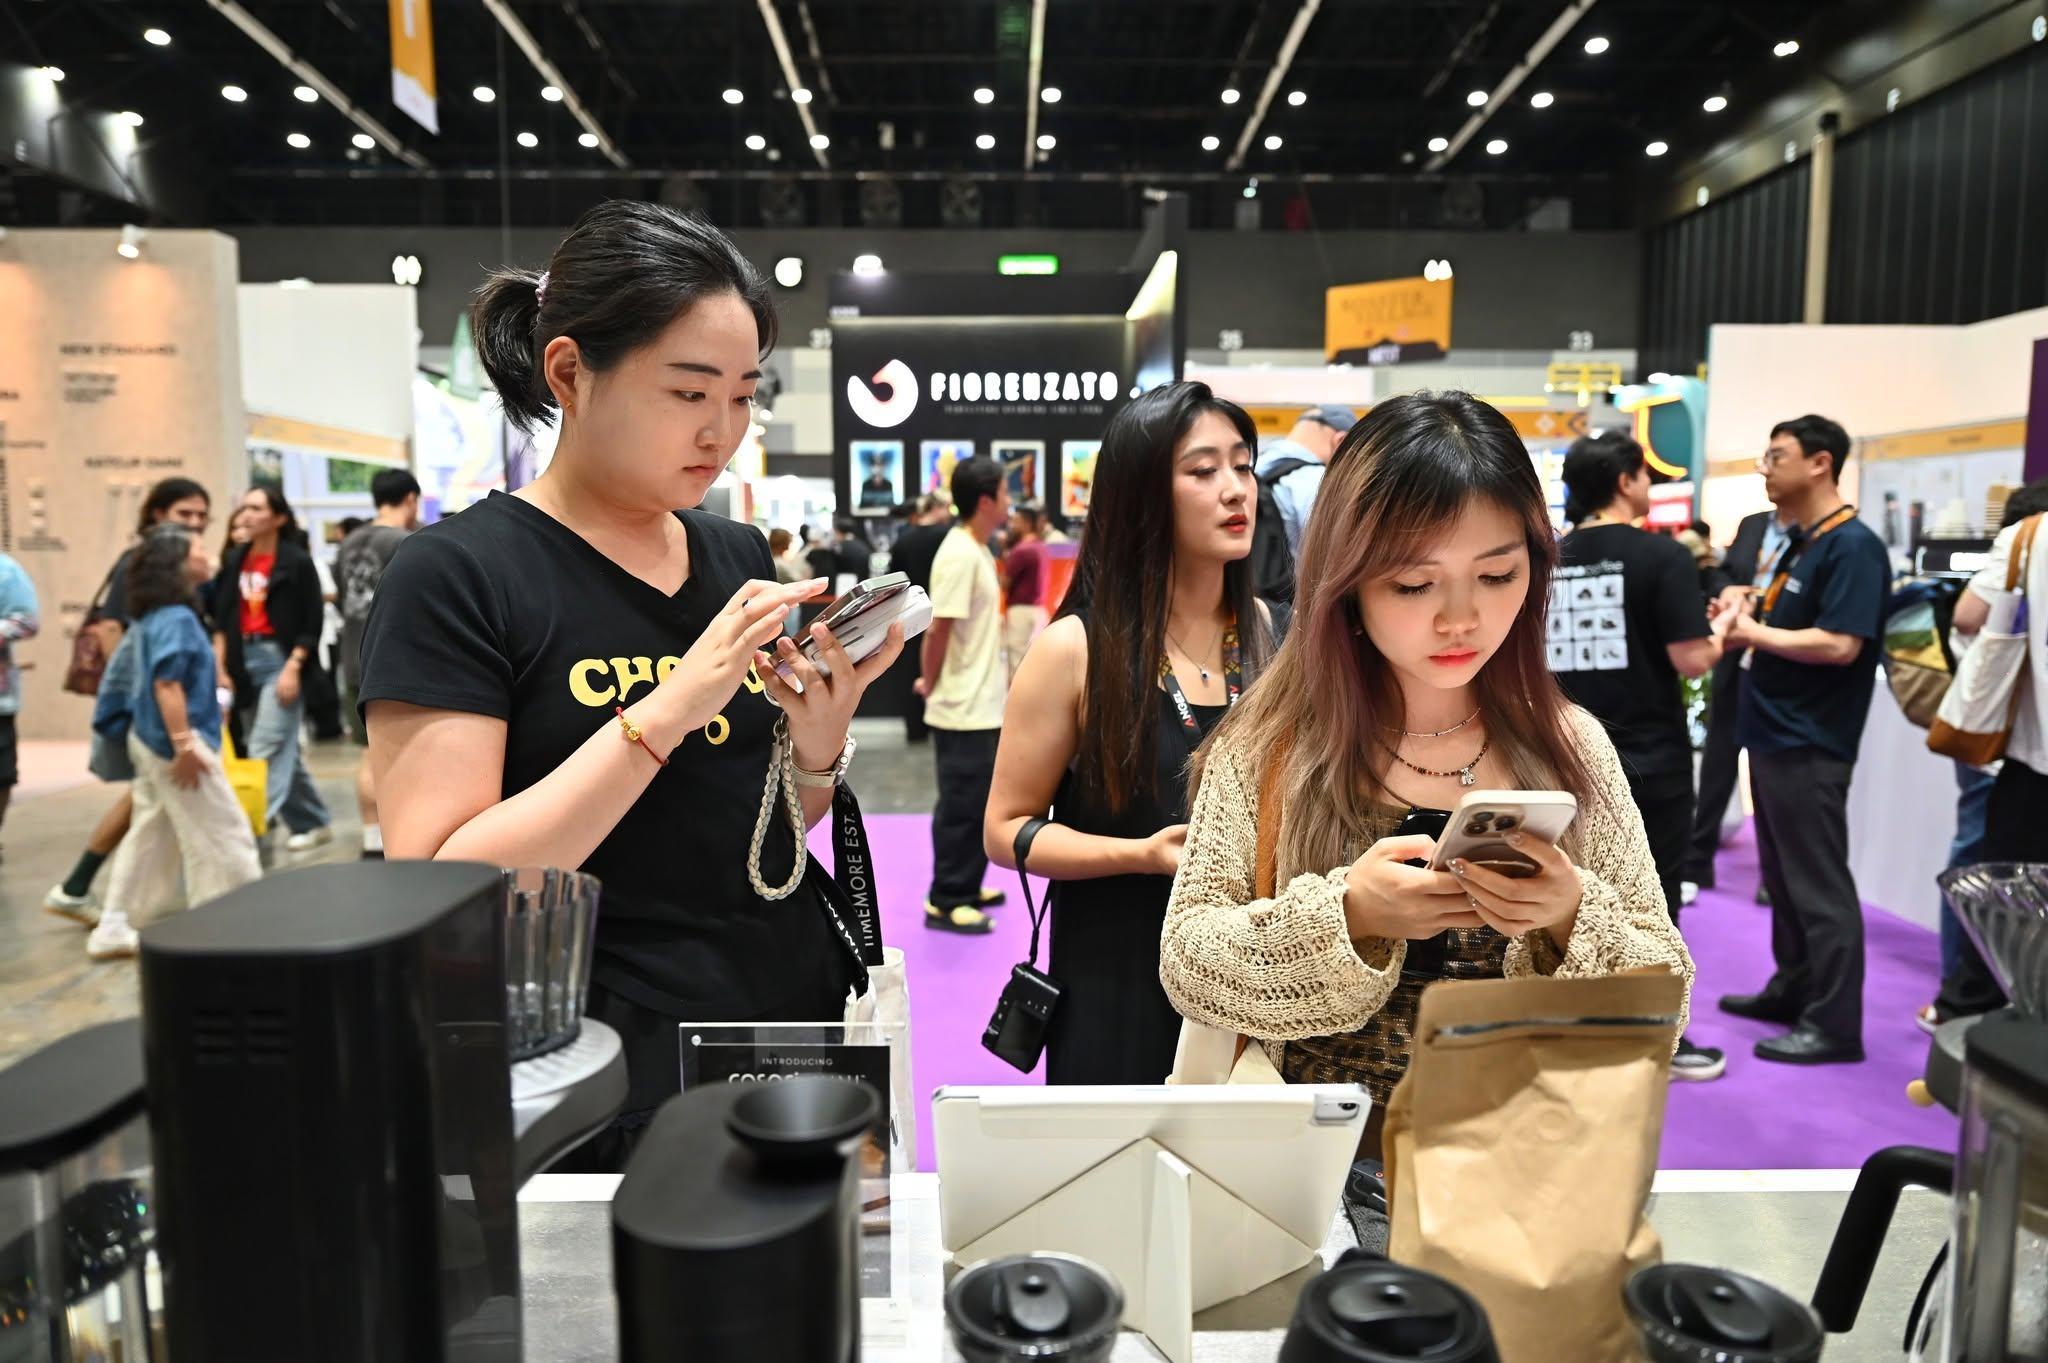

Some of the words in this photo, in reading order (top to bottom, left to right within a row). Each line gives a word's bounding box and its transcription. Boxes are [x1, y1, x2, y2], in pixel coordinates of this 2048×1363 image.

[931, 371, 1118, 401] FIORENZATO
[1172, 689, 1195, 728] ANGEL
[843, 813, 859, 847] EST.
[761, 1057, 834, 1066] INTRODUCING
